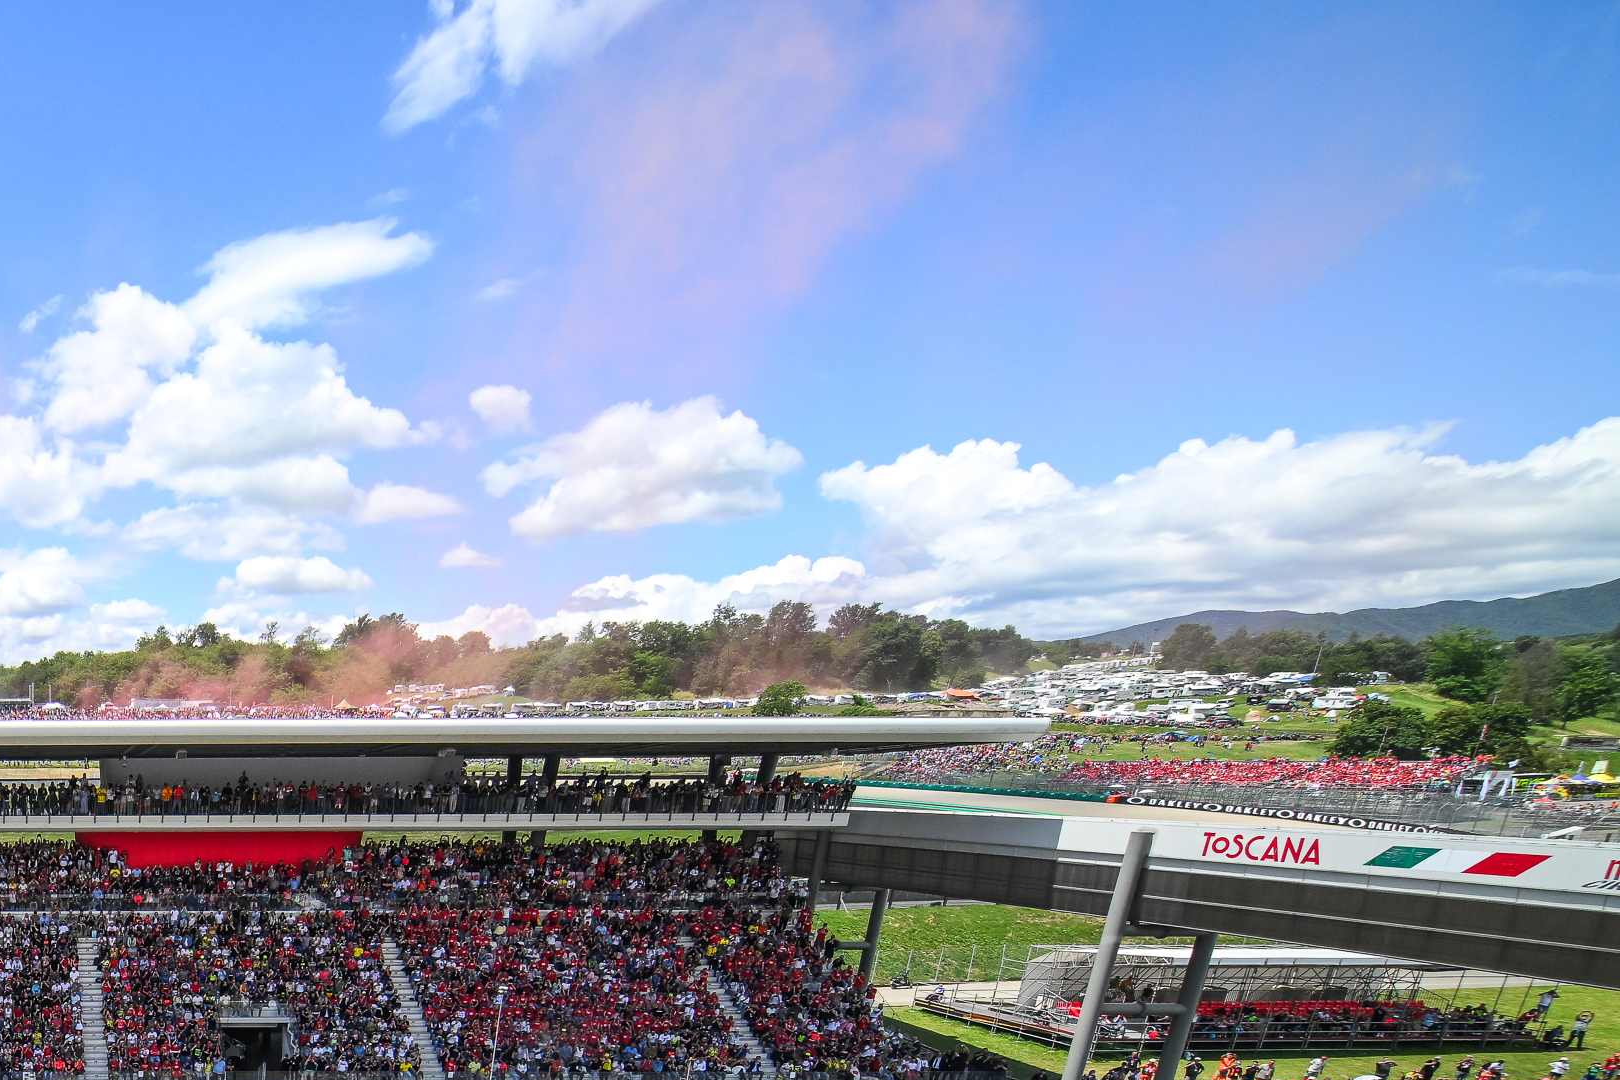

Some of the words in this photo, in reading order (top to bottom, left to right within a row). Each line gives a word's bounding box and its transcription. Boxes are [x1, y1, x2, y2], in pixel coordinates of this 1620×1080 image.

[1148, 798, 1202, 809] OAKLEY
[1225, 805, 1277, 816] OAKLEY
[1296, 812, 1349, 825] OAKLEY
